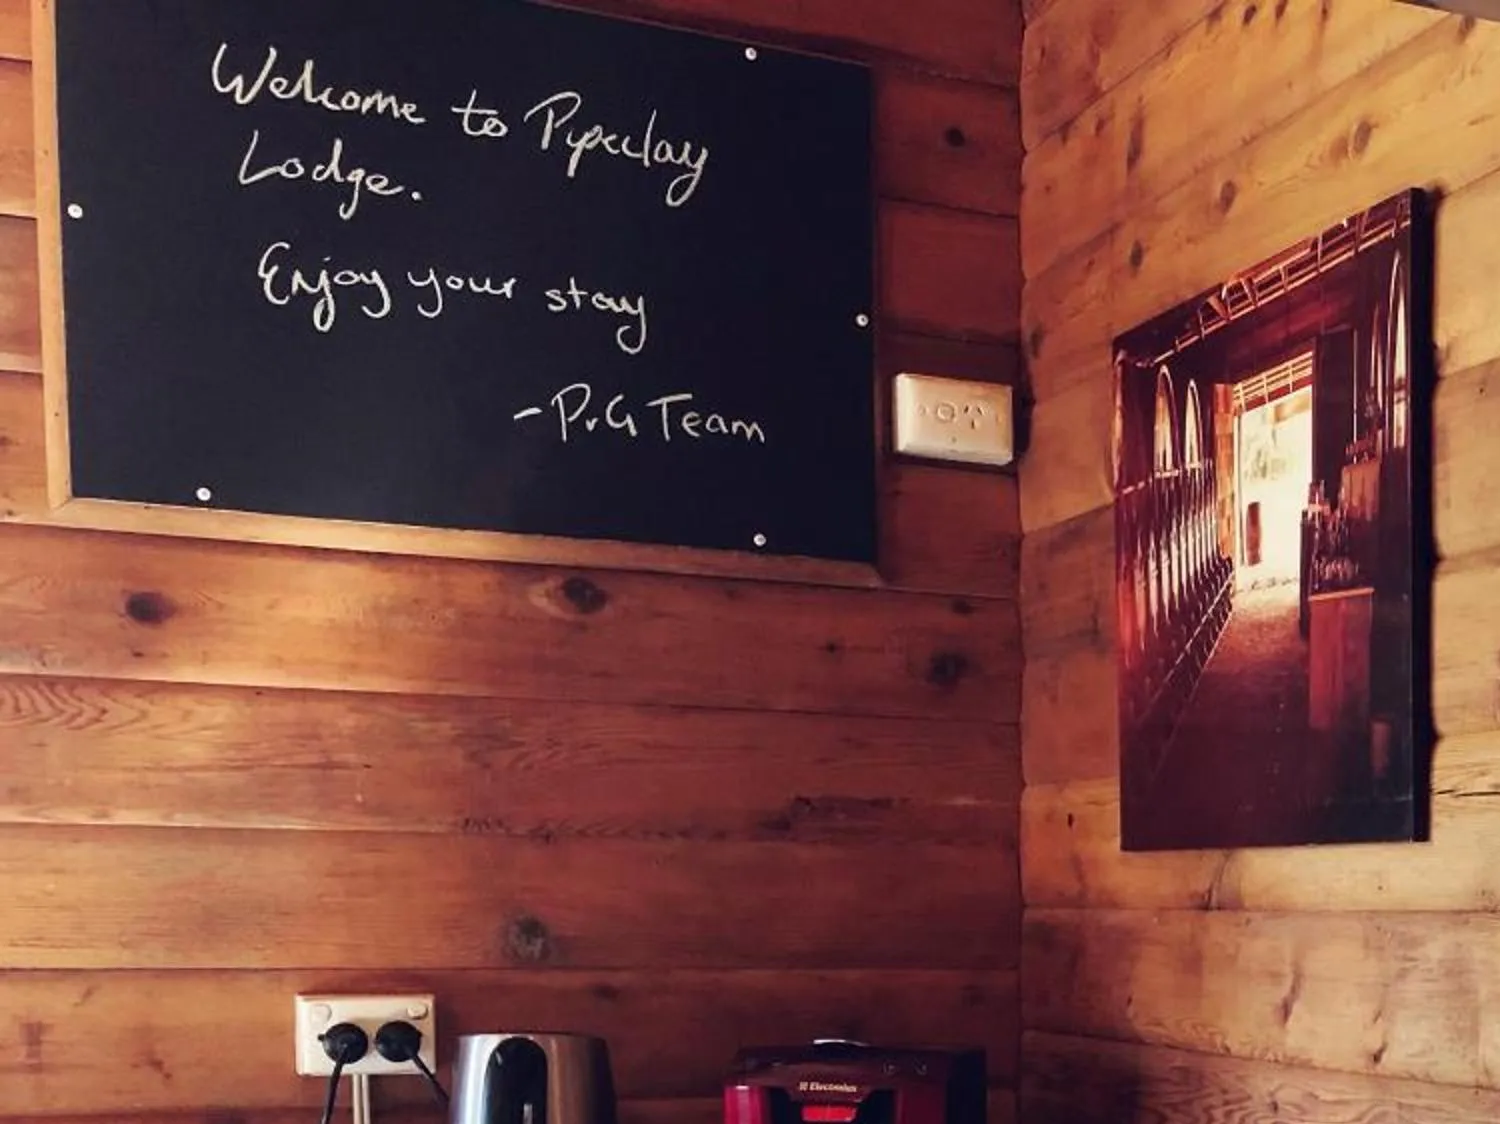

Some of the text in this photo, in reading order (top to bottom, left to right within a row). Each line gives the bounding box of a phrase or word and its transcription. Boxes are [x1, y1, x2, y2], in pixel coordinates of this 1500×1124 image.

[211, 42, 426, 126] Welcome
[450, 89, 509, 137] to
[238, 129, 422, 221] Lodge.
[257, 241, 648, 355] Enjoy your stay
[646, 393, 765, 443] Team
